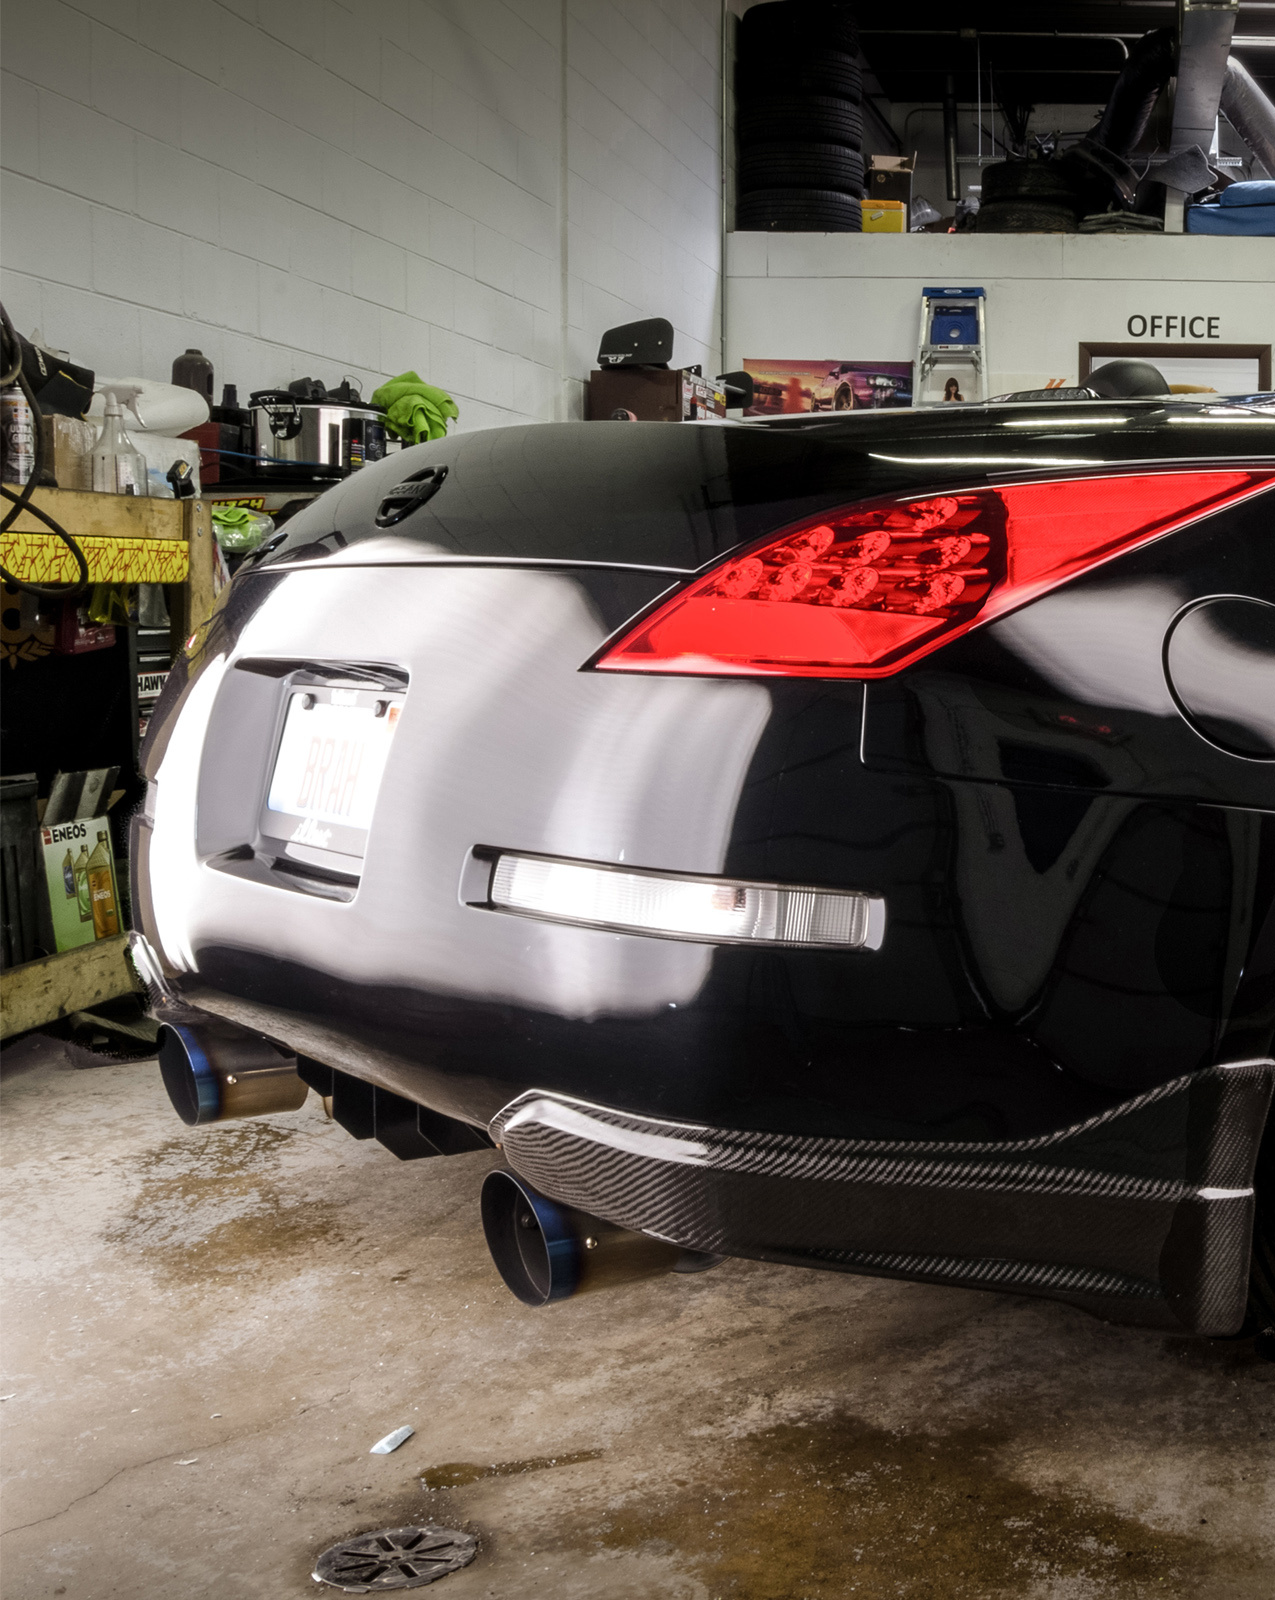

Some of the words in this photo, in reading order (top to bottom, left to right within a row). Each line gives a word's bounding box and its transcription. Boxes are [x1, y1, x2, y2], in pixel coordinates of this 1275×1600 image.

[1127, 314, 1220, 338] OFFICE
[52, 823, 87, 843] ENEOS
[93, 890, 111, 901] ENEOS
